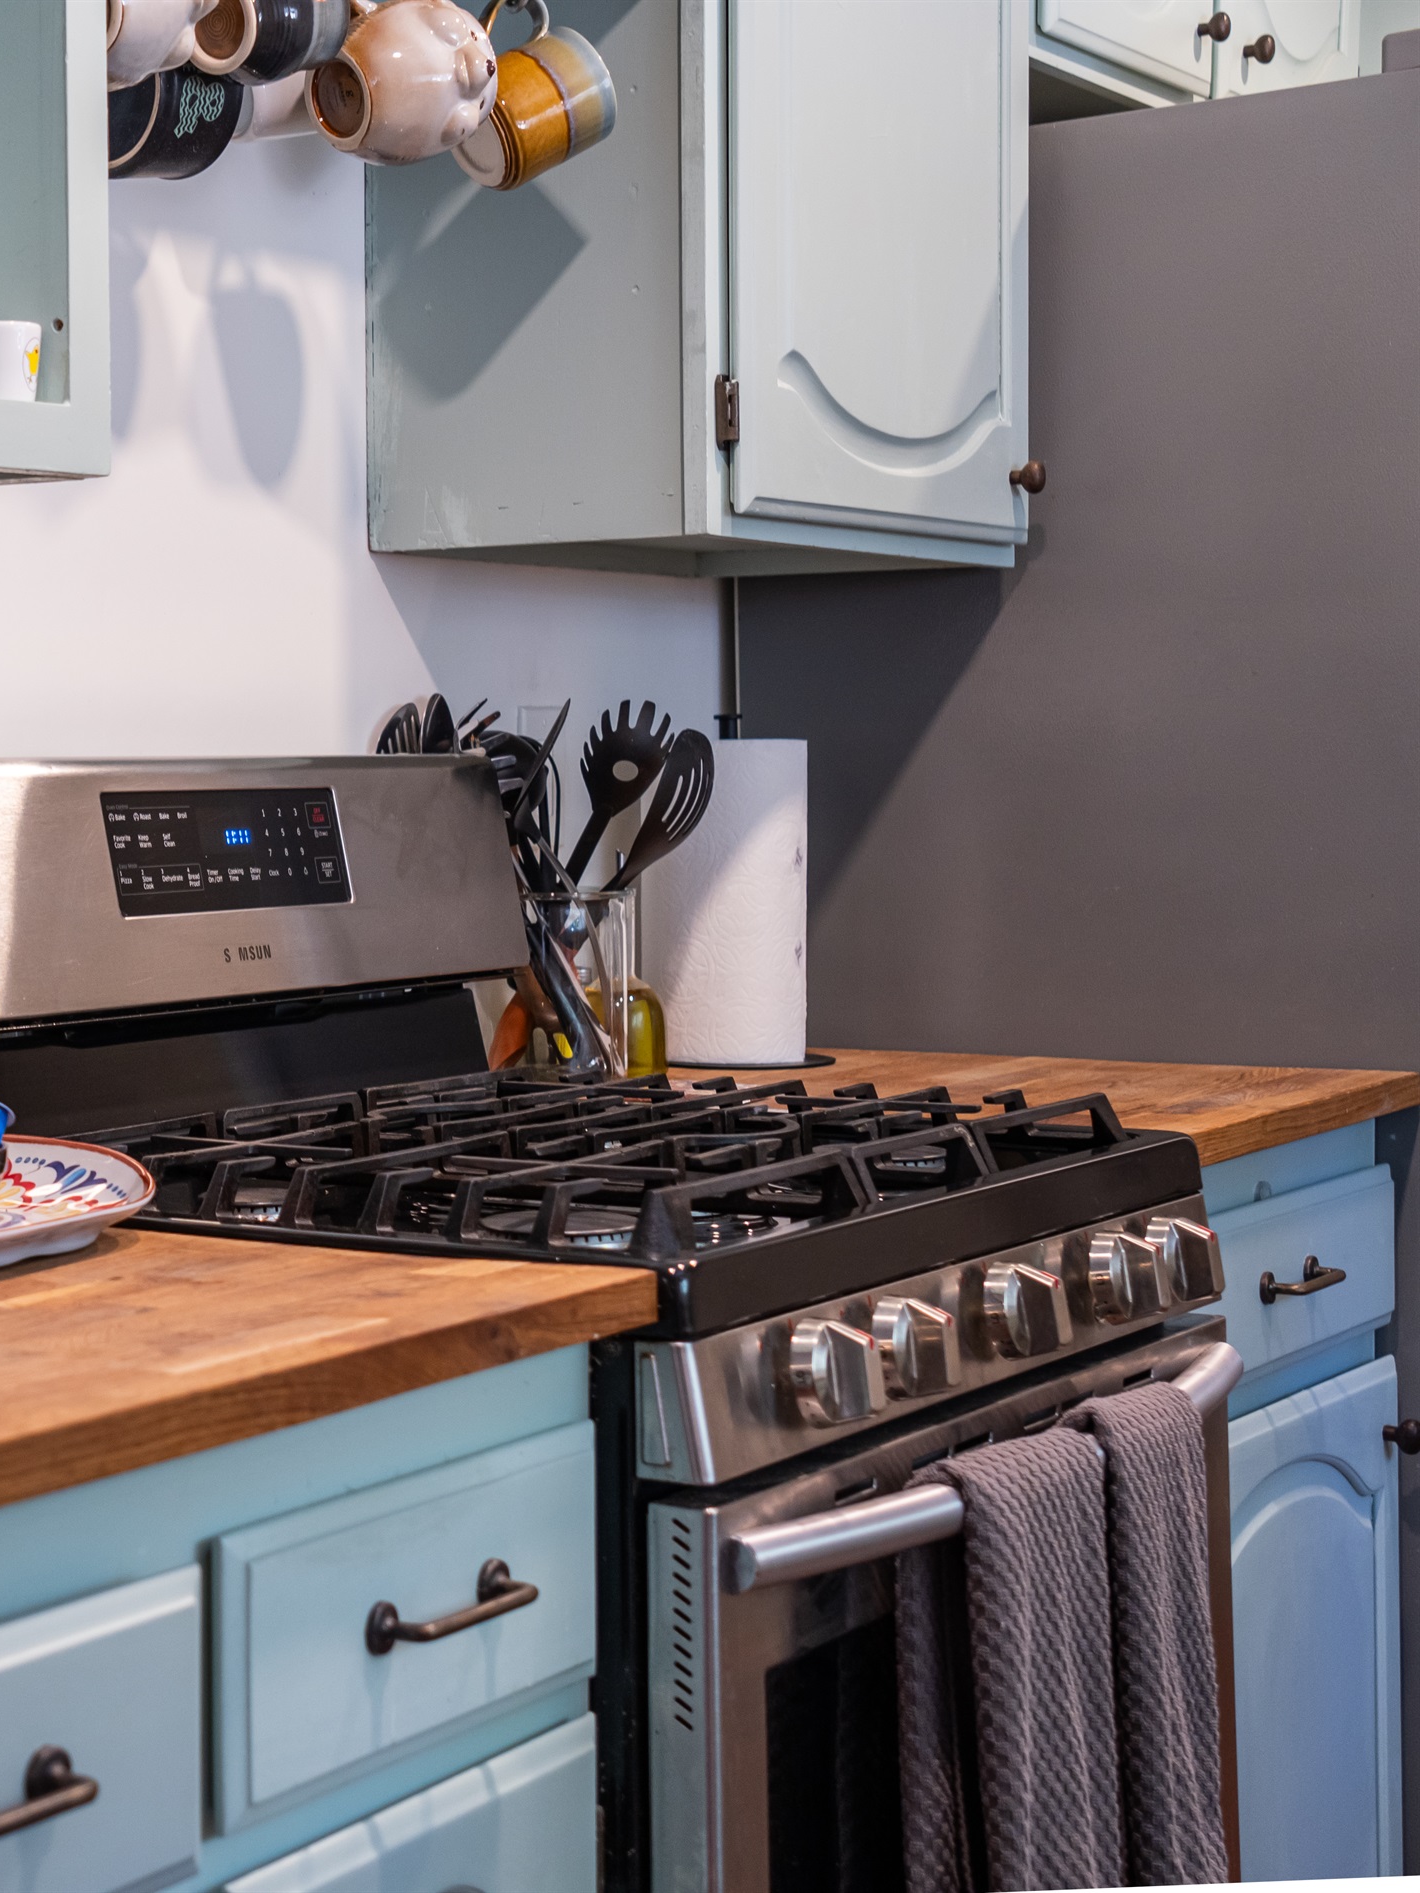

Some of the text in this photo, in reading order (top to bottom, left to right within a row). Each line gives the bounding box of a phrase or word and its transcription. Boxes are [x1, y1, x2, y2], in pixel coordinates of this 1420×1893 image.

[159, 812, 170, 820] Bake
[177, 811, 187, 819] Broil
[261, 808, 266, 818] 1
[277, 807, 282, 817] 2
[293, 807, 298, 817] 3
[264, 828, 270, 837] 4
[280, 827, 285, 837] 5
[296, 826, 301, 836] 6
[268, 848, 272, 857] 7
[284, 847, 289, 857] 8
[300, 846, 305, 856] 9
[269, 869, 280, 877] Clock
[161, 875, 184, 883] Dehydrate
